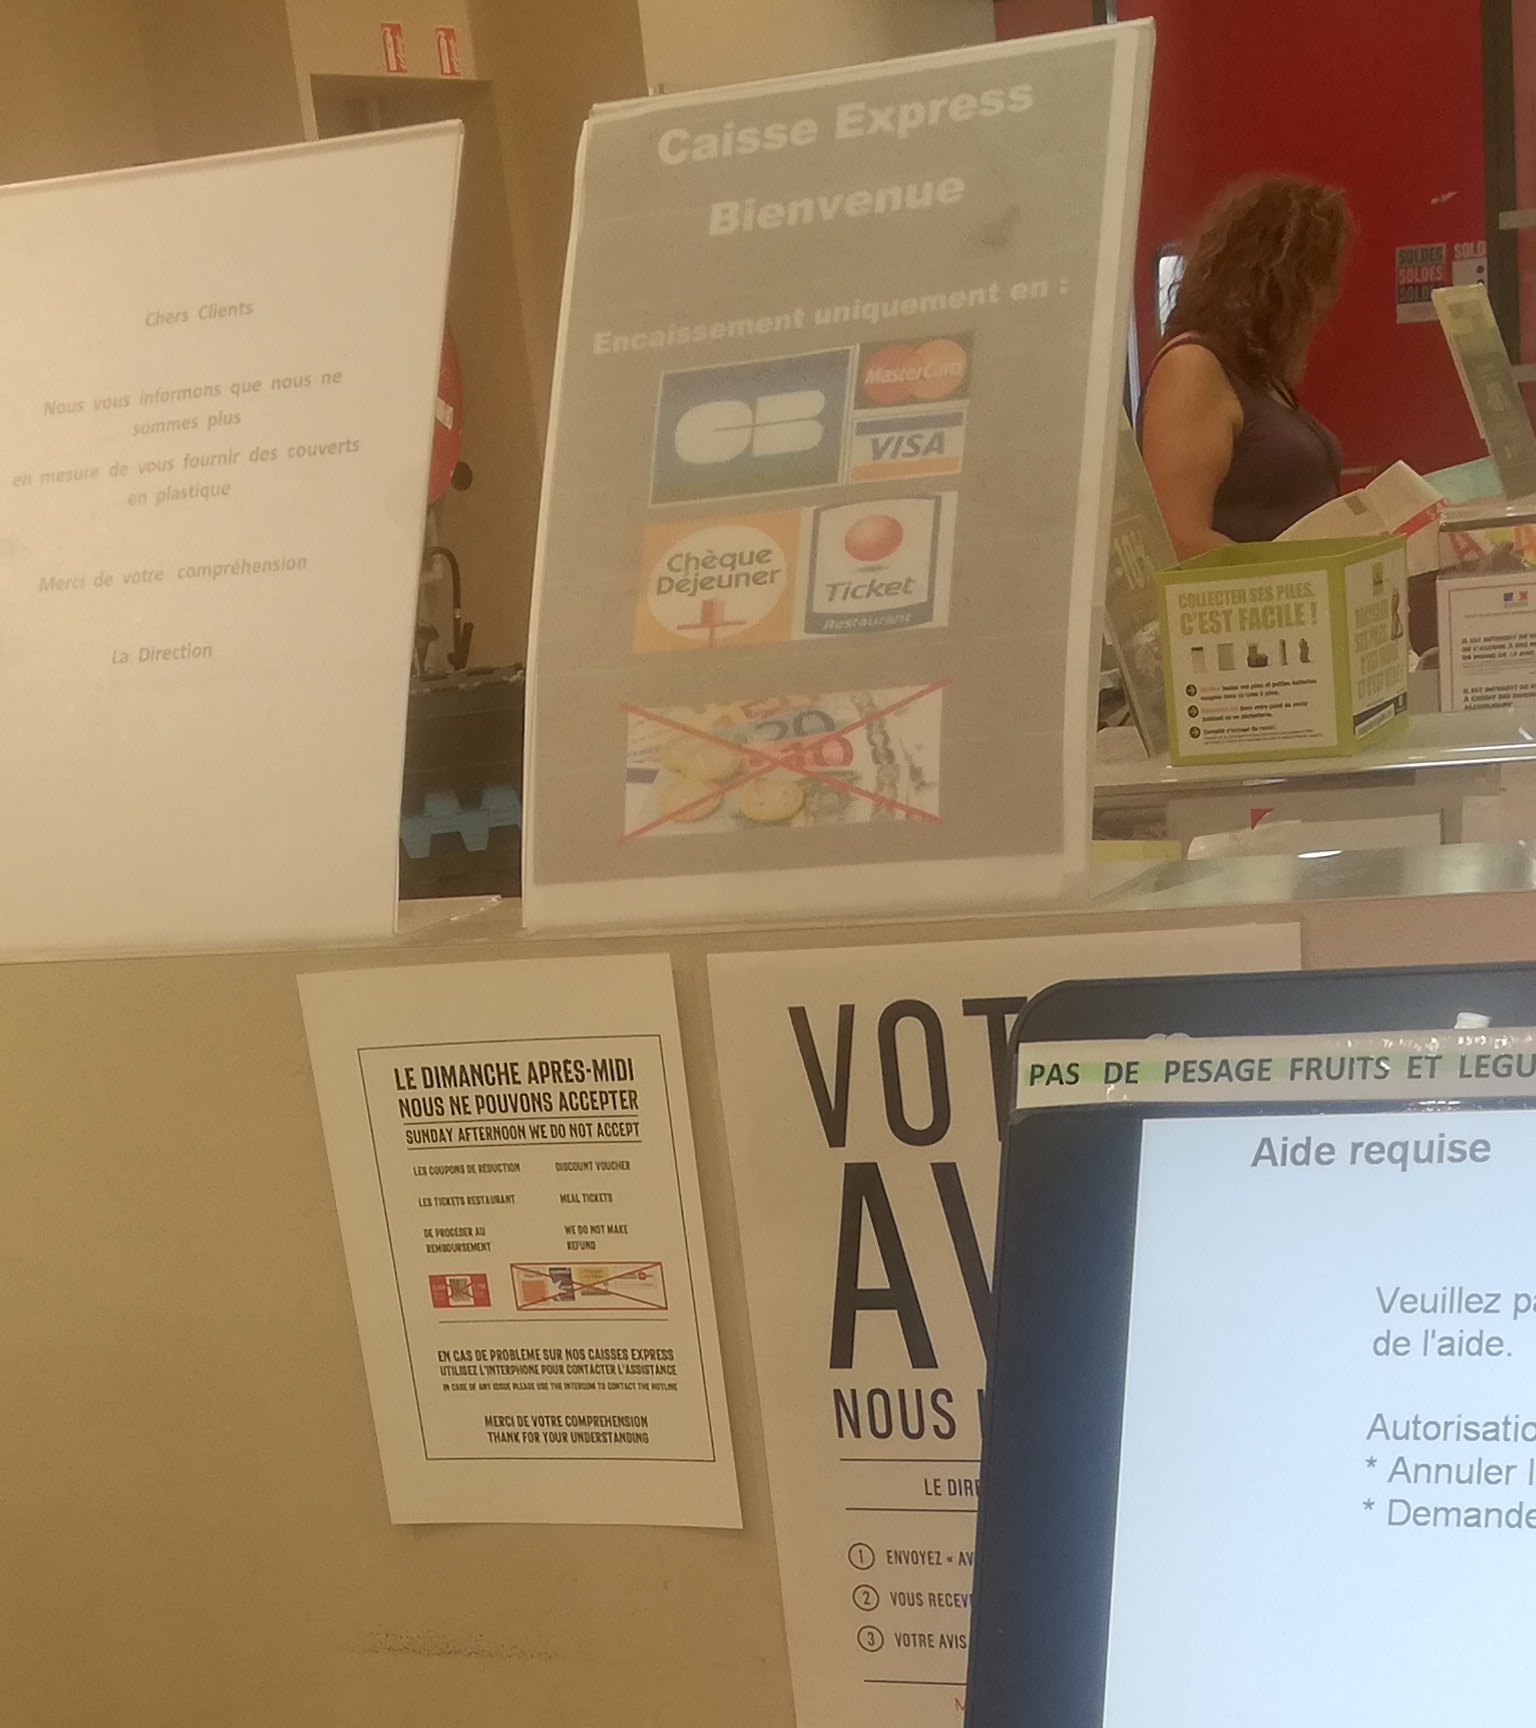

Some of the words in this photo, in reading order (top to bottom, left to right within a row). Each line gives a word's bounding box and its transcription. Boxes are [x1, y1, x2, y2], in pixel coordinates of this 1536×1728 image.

[657, 117, 818, 165] Caisse
[834, 84, 1035, 140] Express
[708, 176, 966, 237] Bienvenue
[1398, 245, 1443, 265] SOLDES
[145, 310, 189, 328] Chers
[198, 301, 254, 321] Clients
[592, 306, 805, 356] Encaissement
[814, 279, 999, 324] uniquement
[1010, 278, 1049, 300] en
[864, 358, 964, 387] MasterCard
[870, 431, 946, 462] VISA
[666, 546, 774, 574] Chèque
[656, 566, 782, 597] Déjeuner
[825, 575, 917, 603] Ticket
[1180, 608, 1234, 637] C'EST
[1238, 601, 1306, 632] FACILE
[111, 648, 129, 665] La
[138, 642, 213, 663] Direction
[394, 1067, 417, 1091] LE
[421, 1061, 522, 1090] DIMANCHE
[527, 1057, 635, 1085] APRÈS-MIDI
[1028, 1061, 1081, 1087] PAS
[1103, 1060, 1141, 1085] DE
[1162, 1056, 1273, 1084] PESAGE
[1288, 1054, 1391, 1081] FRUITS
[1406, 1054, 1441, 1080] ET
[398, 1097, 445, 1119] NOUS
[449, 1095, 472, 1116] NE
[475, 1092, 554, 1115] POUVONS
[559, 1089, 640, 1112] ACCEPTER
[405, 1126, 453, 1145] SUNDAY
[458, 1124, 527, 1142] AFTERNOON
[529, 1123, 549, 1140] WE
[550, 1122, 567, 1139] DO
[569, 1122, 594, 1139] NOT
[597, 1121, 640, 1138] ACCEPT
[1250, 1135, 1336, 1169] Aide
[1349, 1133, 1492, 1174] requise
[1375, 1285, 1502, 1316] Veuillez
[1372, 1327, 1412, 1359] de
[1421, 1327, 1513, 1359] l'aide.
[833, 1386, 957, 1441] NOUS
[1387, 1456, 1518, 1487] Annuler
[885, 1549, 943, 1565] ENVOYEZ
[889, 1591, 924, 1607] VOUS
[893, 1632, 935, 1649] VOTRE
[939, 1634, 967, 1650] AVIS
